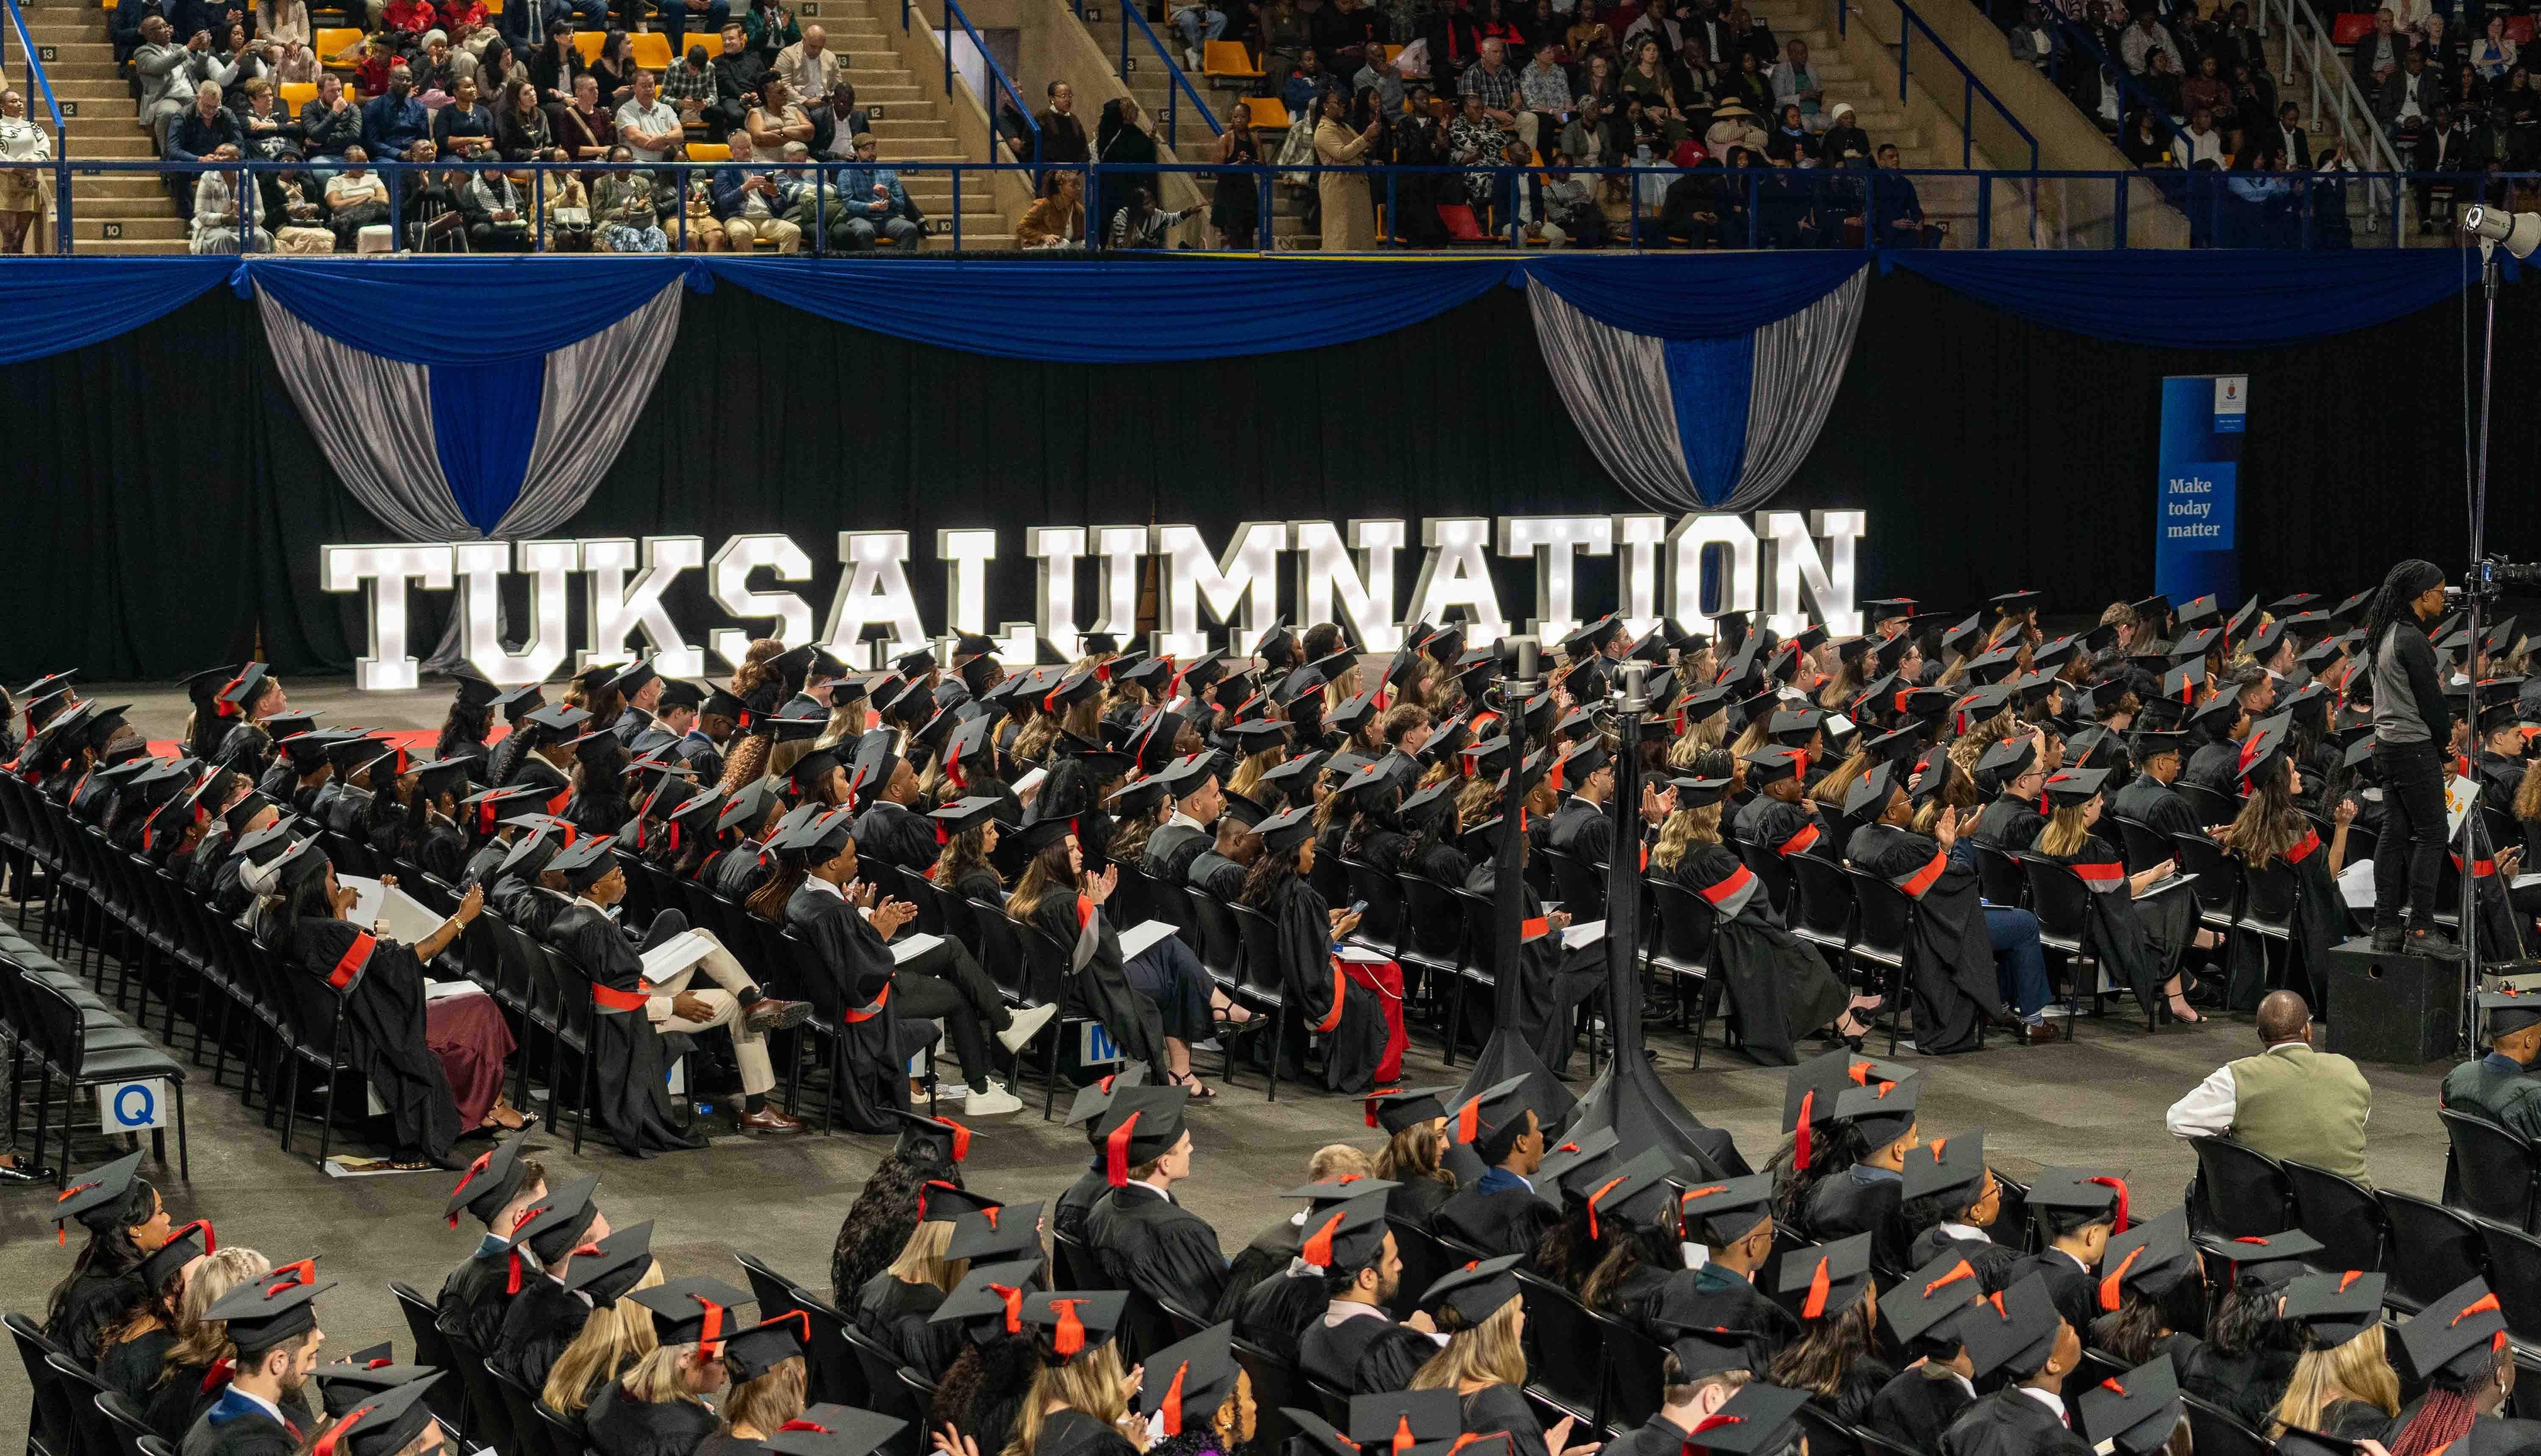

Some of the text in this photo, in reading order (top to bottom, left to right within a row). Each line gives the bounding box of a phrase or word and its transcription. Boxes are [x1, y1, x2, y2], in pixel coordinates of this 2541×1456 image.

[43, 50, 53, 59] 13
[63, 104, 74, 114] 12
[870, 108, 881, 117] 12
[106, 225, 119, 236] 10
[941, 221, 952, 231] 10
[2168, 478, 2212, 494] Make
[2168, 500, 2212, 519] today
[2168, 523, 2220, 538] matter
[320, 509, 1867, 691] TUKSALUMNATION
[1091, 1024, 1125, 1061] M
[114, 1084, 155, 1125] Q
